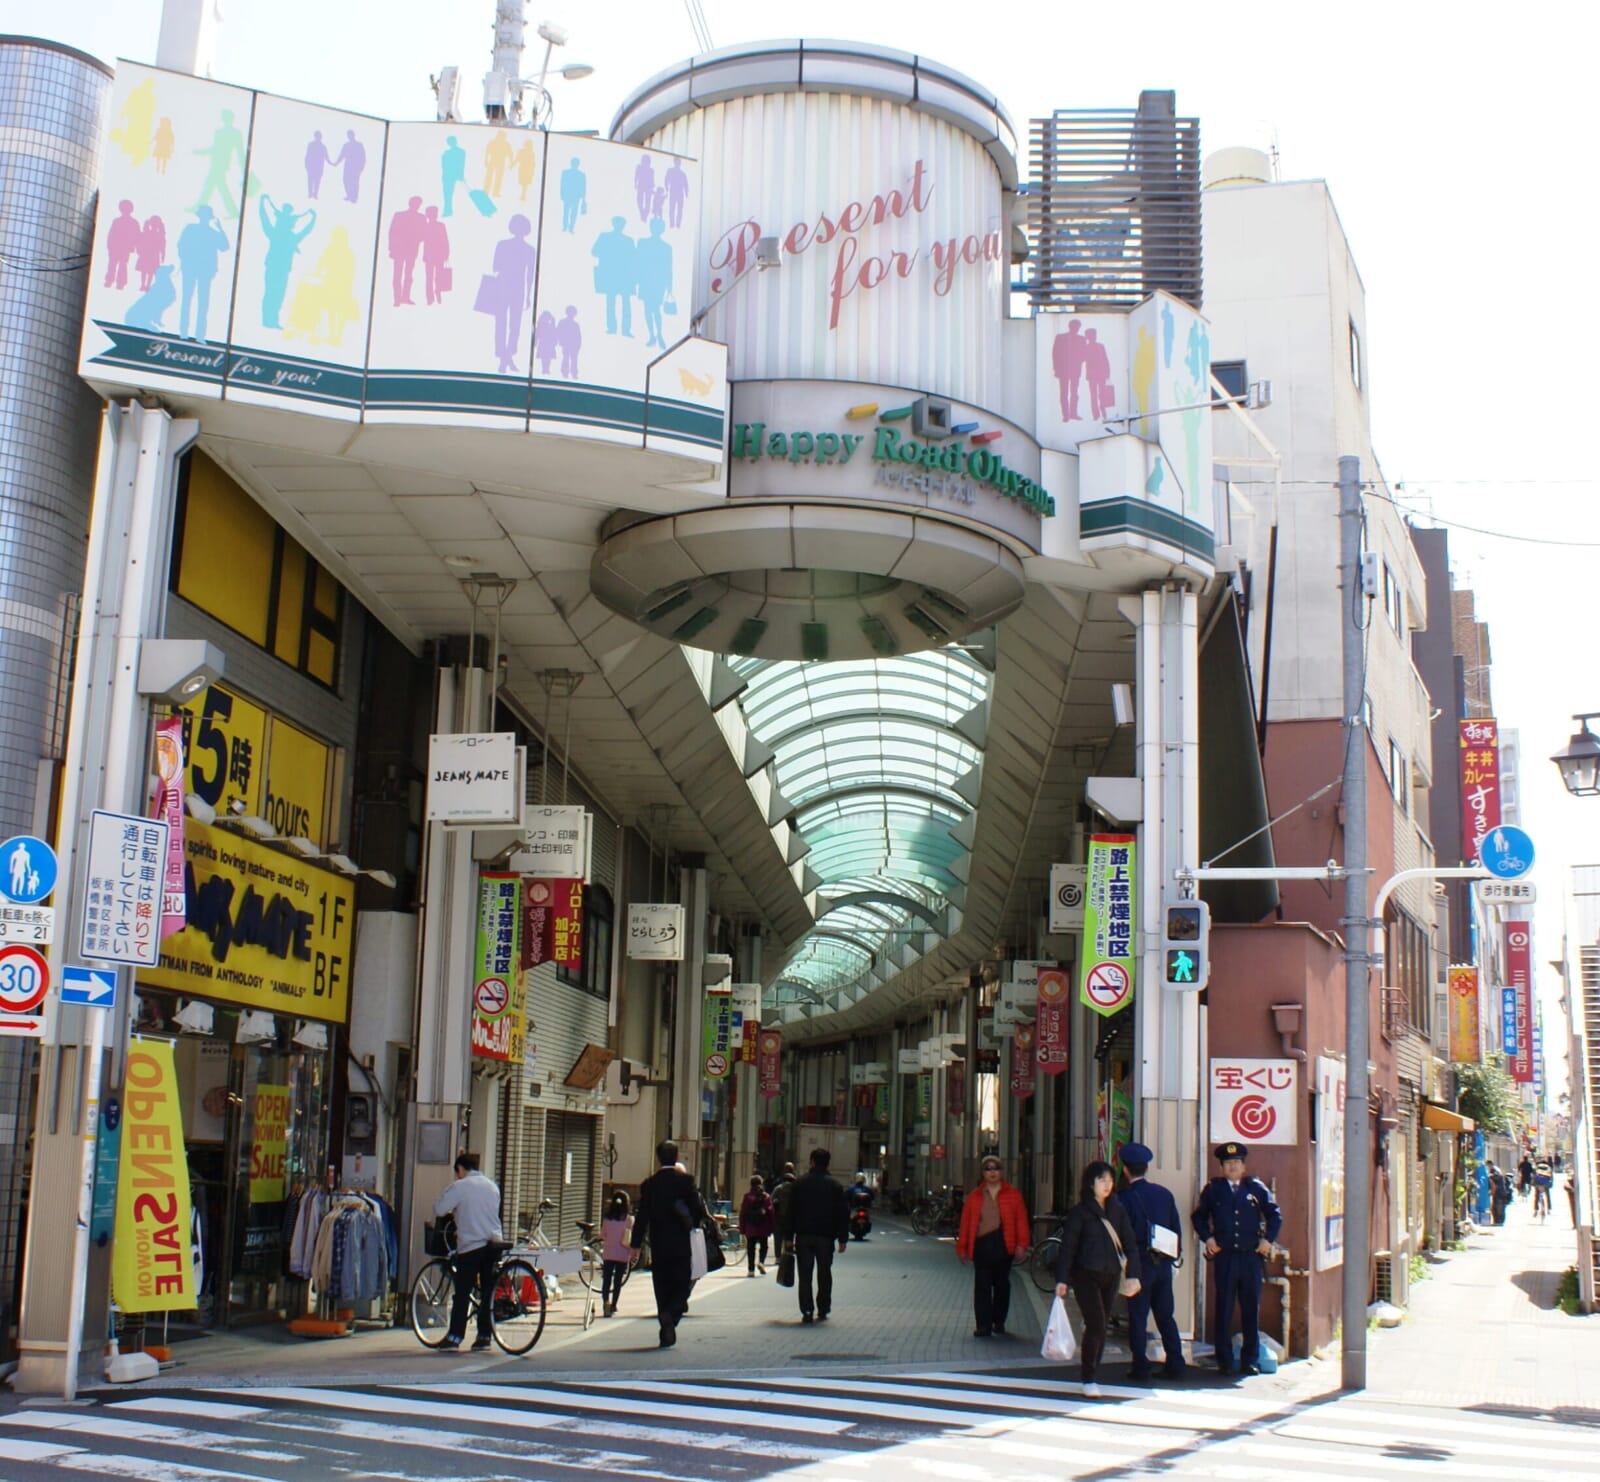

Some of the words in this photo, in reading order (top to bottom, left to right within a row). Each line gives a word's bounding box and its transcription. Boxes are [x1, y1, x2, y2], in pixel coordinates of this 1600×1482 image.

[709, 160, 934, 293] Pesent
[828, 237, 918, 330] for
[146, 341, 224, 368] Present
[228, 357, 264, 378] for
[271, 371, 322, 386] you!
[734, 422, 863, 464] Happy
[872, 425, 965, 474] Road
[967, 447, 1056, 517] Ohyama
[434, 770, 471, 784] JEANS
[474, 769, 509, 781] MATE
[1464, 769, 1495, 784] カレー
[1465, 751, 1494, 766] 牛丼
[265, 780, 309, 837] hours
[527, 830, 579, 841] ンコ・印刷
[113, 824, 139, 955] 通行して下さい
[134, 828, 159, 958] 自転車は降りて
[220, 848, 246, 874] loving
[248, 862, 275, 882] nature
[277, 874, 293, 887] and
[294, 879, 310, 896] city
[0, 908, 53, 924] 転車を除く
[319, 891, 346, 940] 1F
[569, 882, 582, 961] ハローカード
[1108, 848, 1130, 958] 路上禁煙地区
[494, 883, 515, 974] 路上禁煙地区
[555, 917, 568, 960] 加盟店
[0, 963, 36, 994] 30
[190, 960, 213, 978] FROM
[216, 967, 264, 988] ANTHOLOGY
[313, 951, 342, 1000] BF
[1215, 1066, 1292, 1090] 宝くじ
[255, 1094, 290, 1121] OPEN
[250, 1144, 286, 1180] SALE
